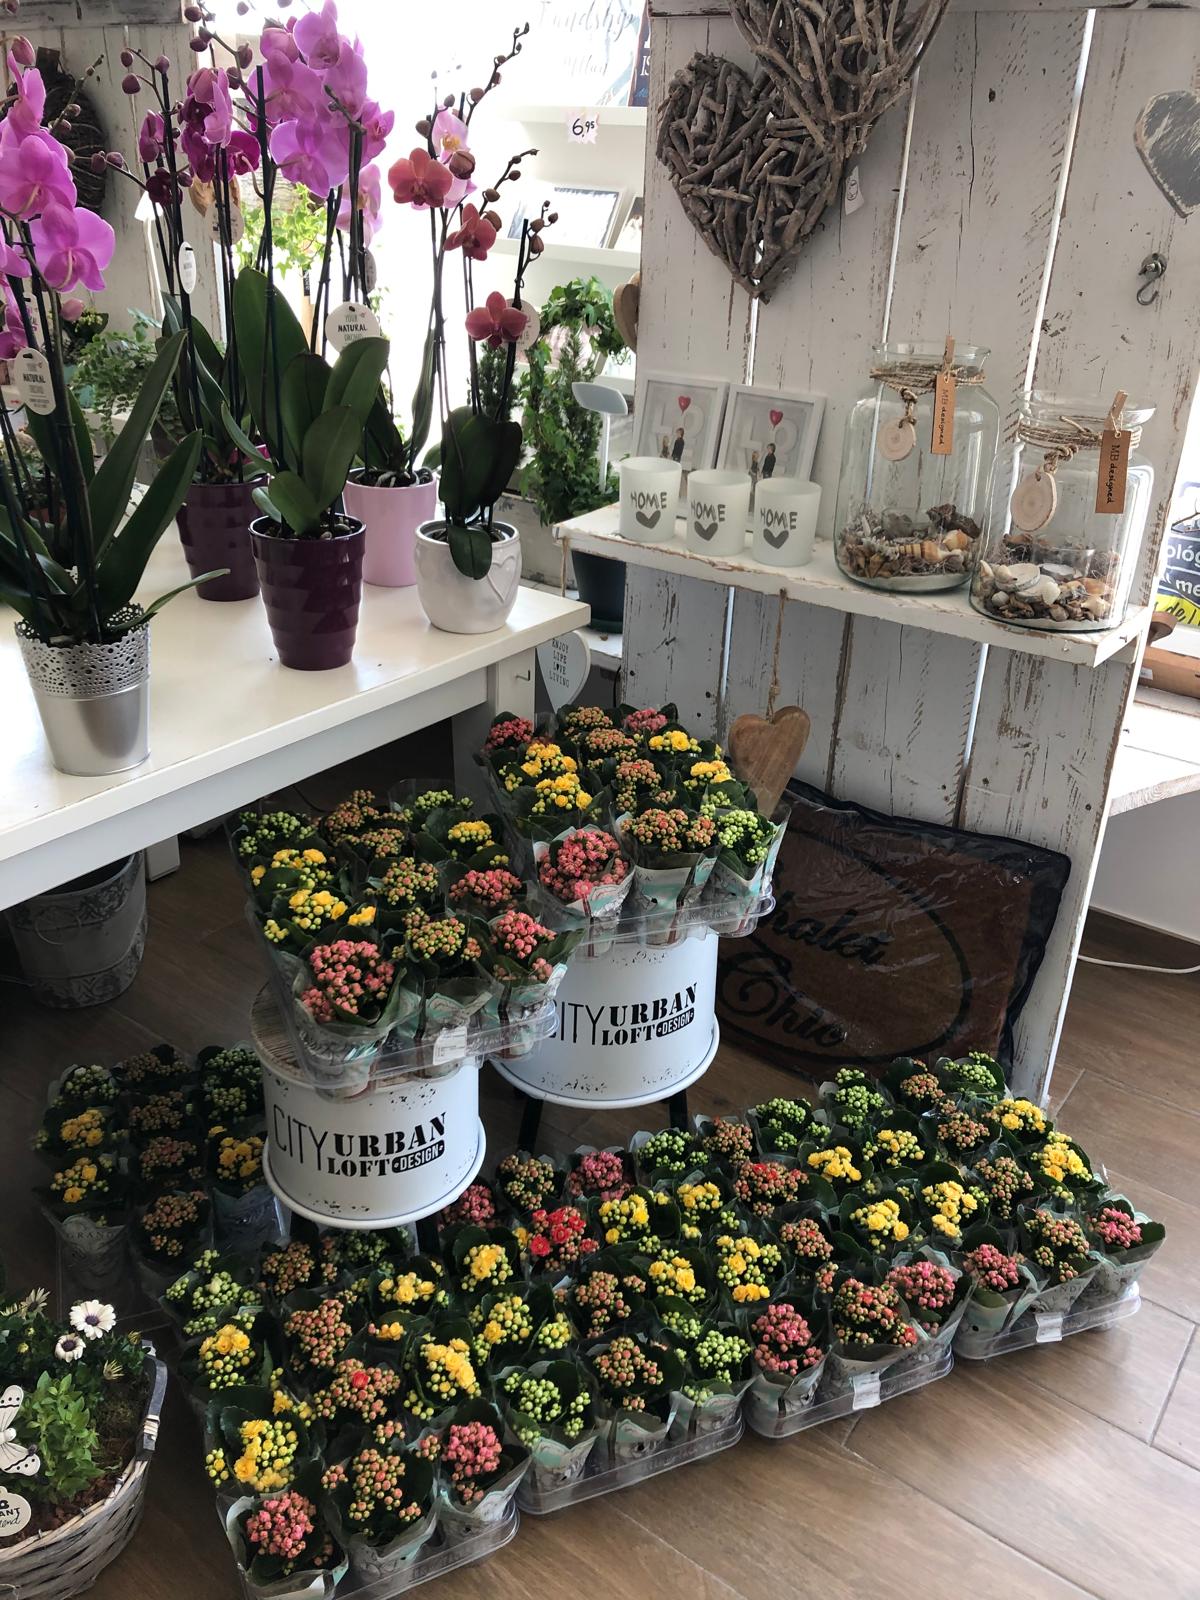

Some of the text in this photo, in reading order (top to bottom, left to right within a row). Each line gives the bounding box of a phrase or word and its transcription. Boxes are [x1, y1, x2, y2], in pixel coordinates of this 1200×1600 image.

[337, 323, 368, 333] NATURAL
[1105, 444, 1121, 504] MB designed
[630, 491, 668, 510] HOME
[691, 500, 726, 522] HOME
[760, 507, 798, 530] HOME
[553, 650, 567, 664] LIFE
[553, 661, 567, 675] LVE
[549, 670, 570, 688] LIVING
[549, 1000, 604, 1045] ITY
[609, 982, 697, 1027] URBAN
[602, 1013, 691, 1046] LOFT DESIGN
[273, 1104, 446, 1171] CITY URBAN
[327, 1147, 440, 1178] LOFT DESIGN
